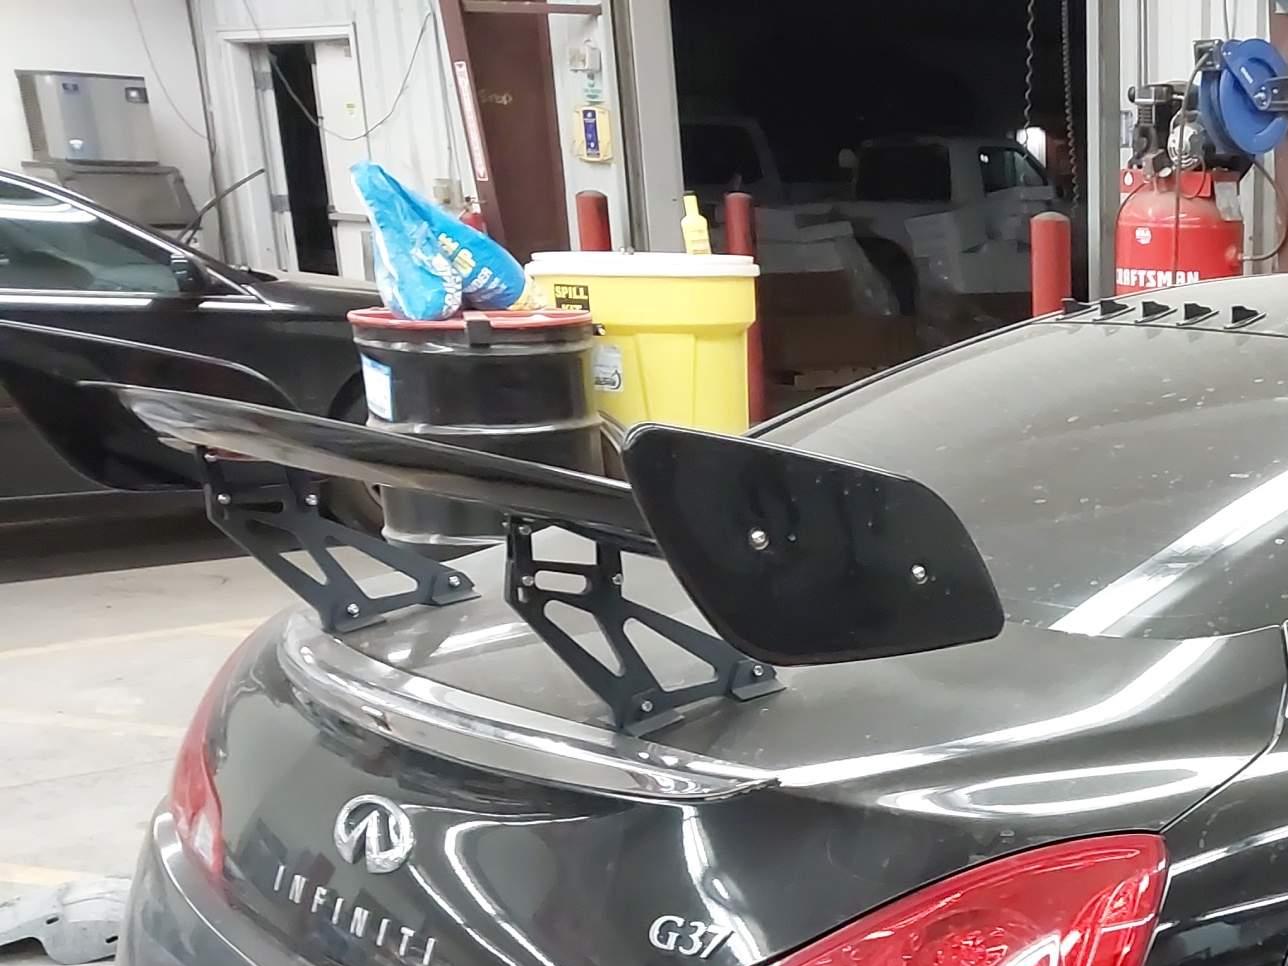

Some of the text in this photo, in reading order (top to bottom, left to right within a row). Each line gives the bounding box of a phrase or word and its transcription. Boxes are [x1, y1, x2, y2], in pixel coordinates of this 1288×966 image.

[555, 285, 589, 299] SPILL
[273, 864, 437, 966] INFINITI
[648, 915, 735, 959] G37
